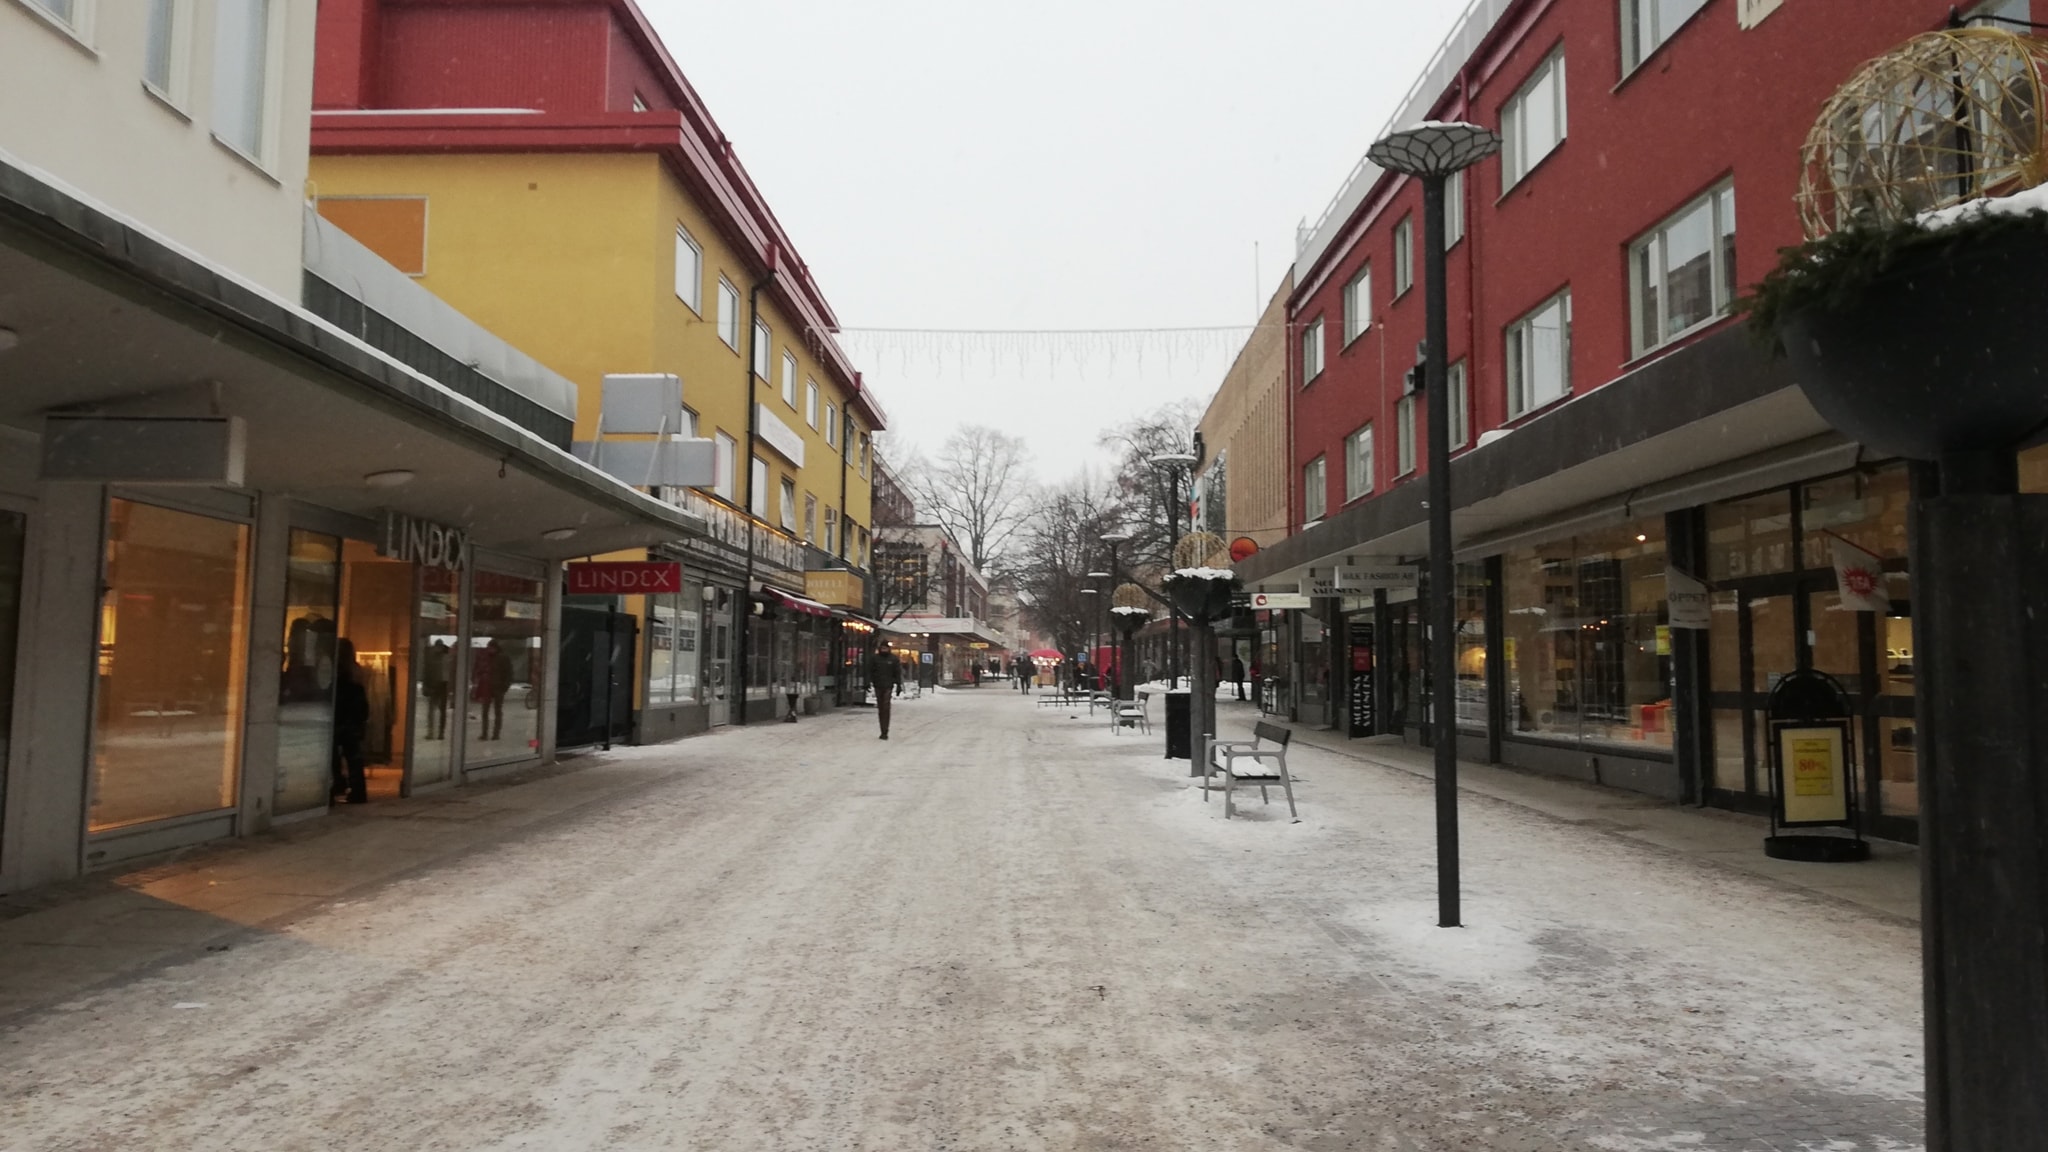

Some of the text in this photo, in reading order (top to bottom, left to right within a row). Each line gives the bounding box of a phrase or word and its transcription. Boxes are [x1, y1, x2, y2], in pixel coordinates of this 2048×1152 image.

[386, 512, 468, 571] LINDEX
[577, 568, 671, 589] LINDEX
[807, 579, 842, 588] HOTELL
[1669, 590, 1706, 602] ÖPPET
